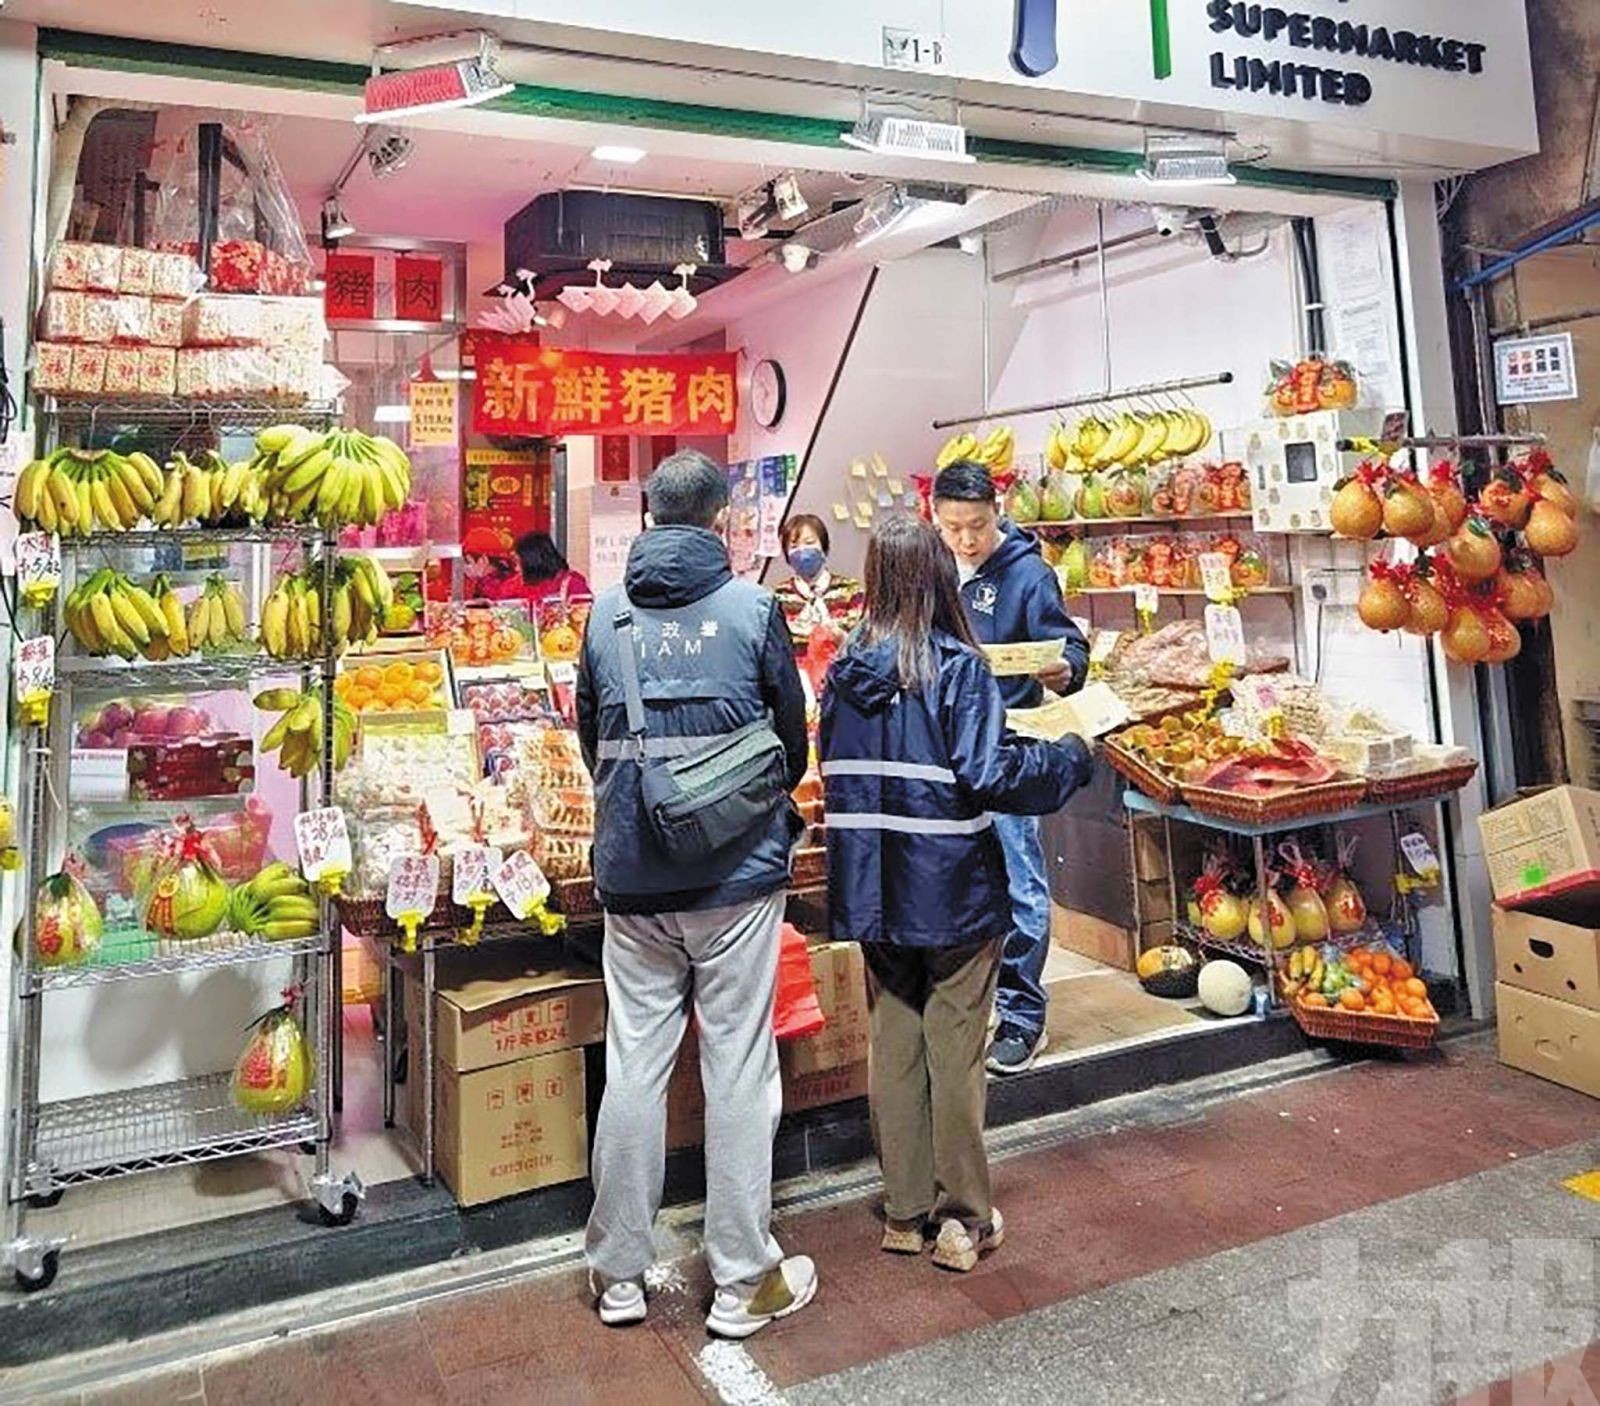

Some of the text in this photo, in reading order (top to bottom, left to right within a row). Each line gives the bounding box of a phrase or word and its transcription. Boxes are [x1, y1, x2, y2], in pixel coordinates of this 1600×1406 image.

[912, 38, 943, 65] 1-B
[1206, 0, 1486, 74] SUPERMARKET
[1209, 51, 1373, 106] LIMITED
